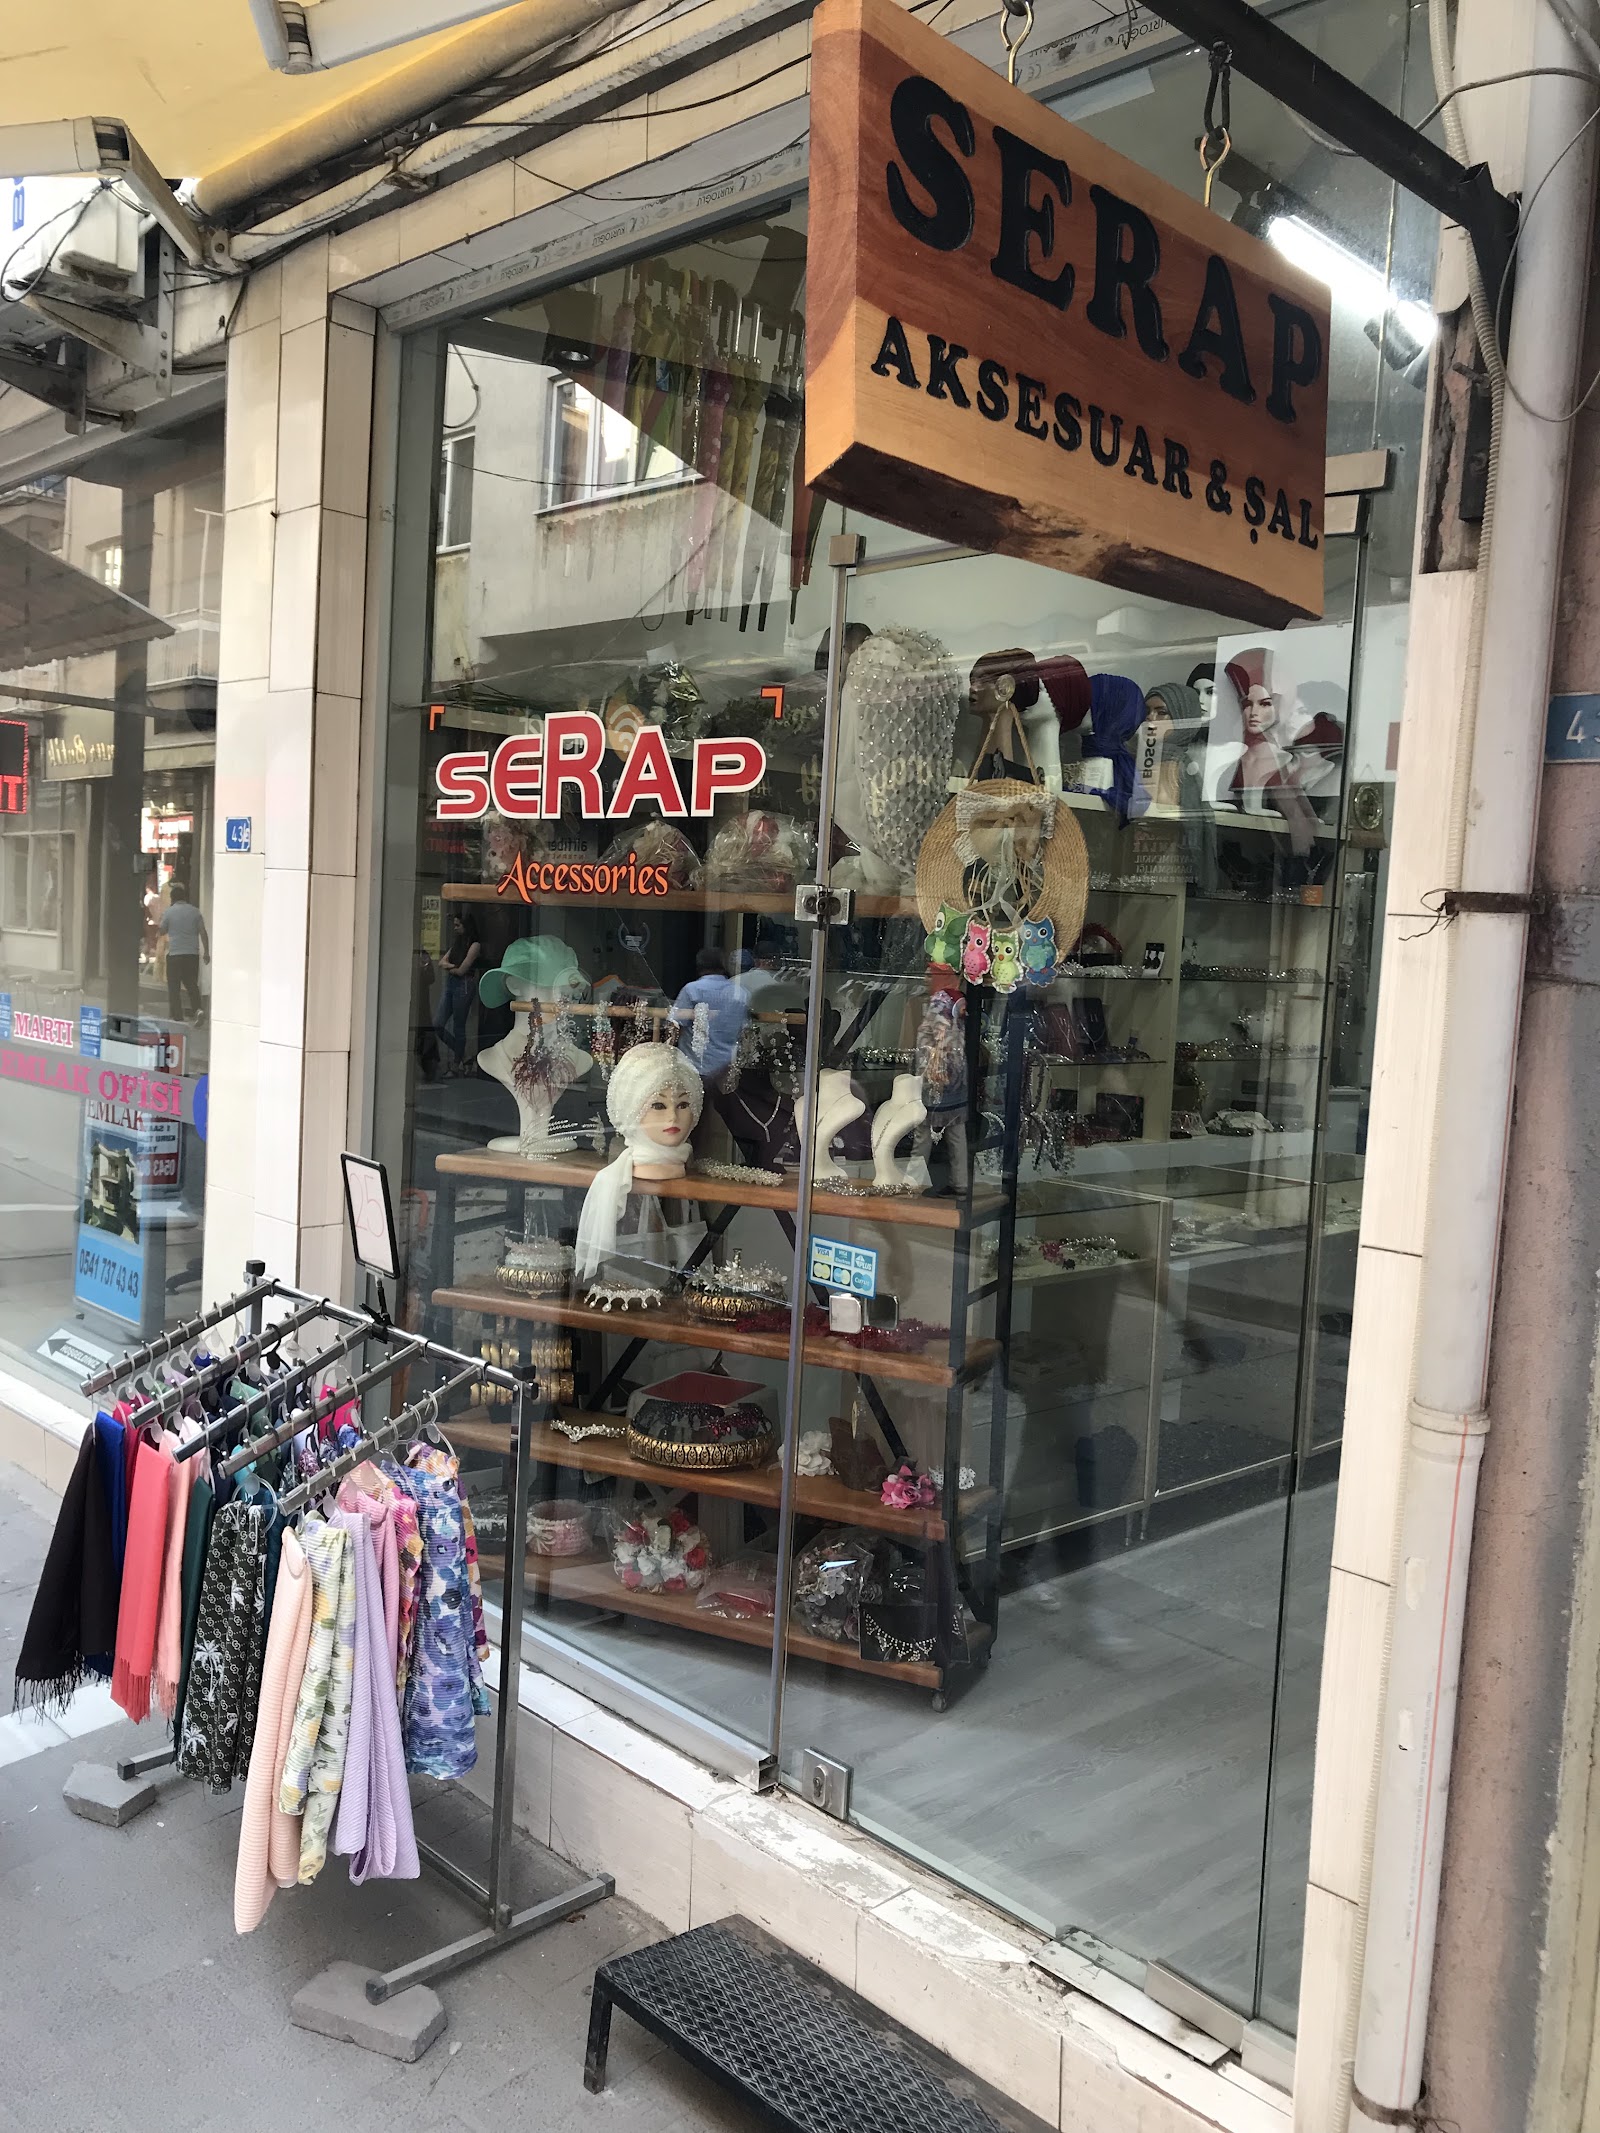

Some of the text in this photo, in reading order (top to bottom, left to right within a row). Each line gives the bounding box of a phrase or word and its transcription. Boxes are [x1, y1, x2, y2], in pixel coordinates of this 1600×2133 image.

[886, 75, 1322, 424] SERAP
[871, 315, 1318, 551] AKSESUAR & ŞAL
[435, 711, 767, 820] SERAP
[497, 850, 669, 903] Accessories
[14, 1013, 73, 1047] MARTI
[0, 1048, 183, 1116] EMLAK OFİSİ
[350, 1173, 384, 1238] 25
[79, 1248, 139, 1298] 0541 737 43 43
[817, 1247, 830, 1257] VISA
[858, 1260, 872, 1270] PLUS
